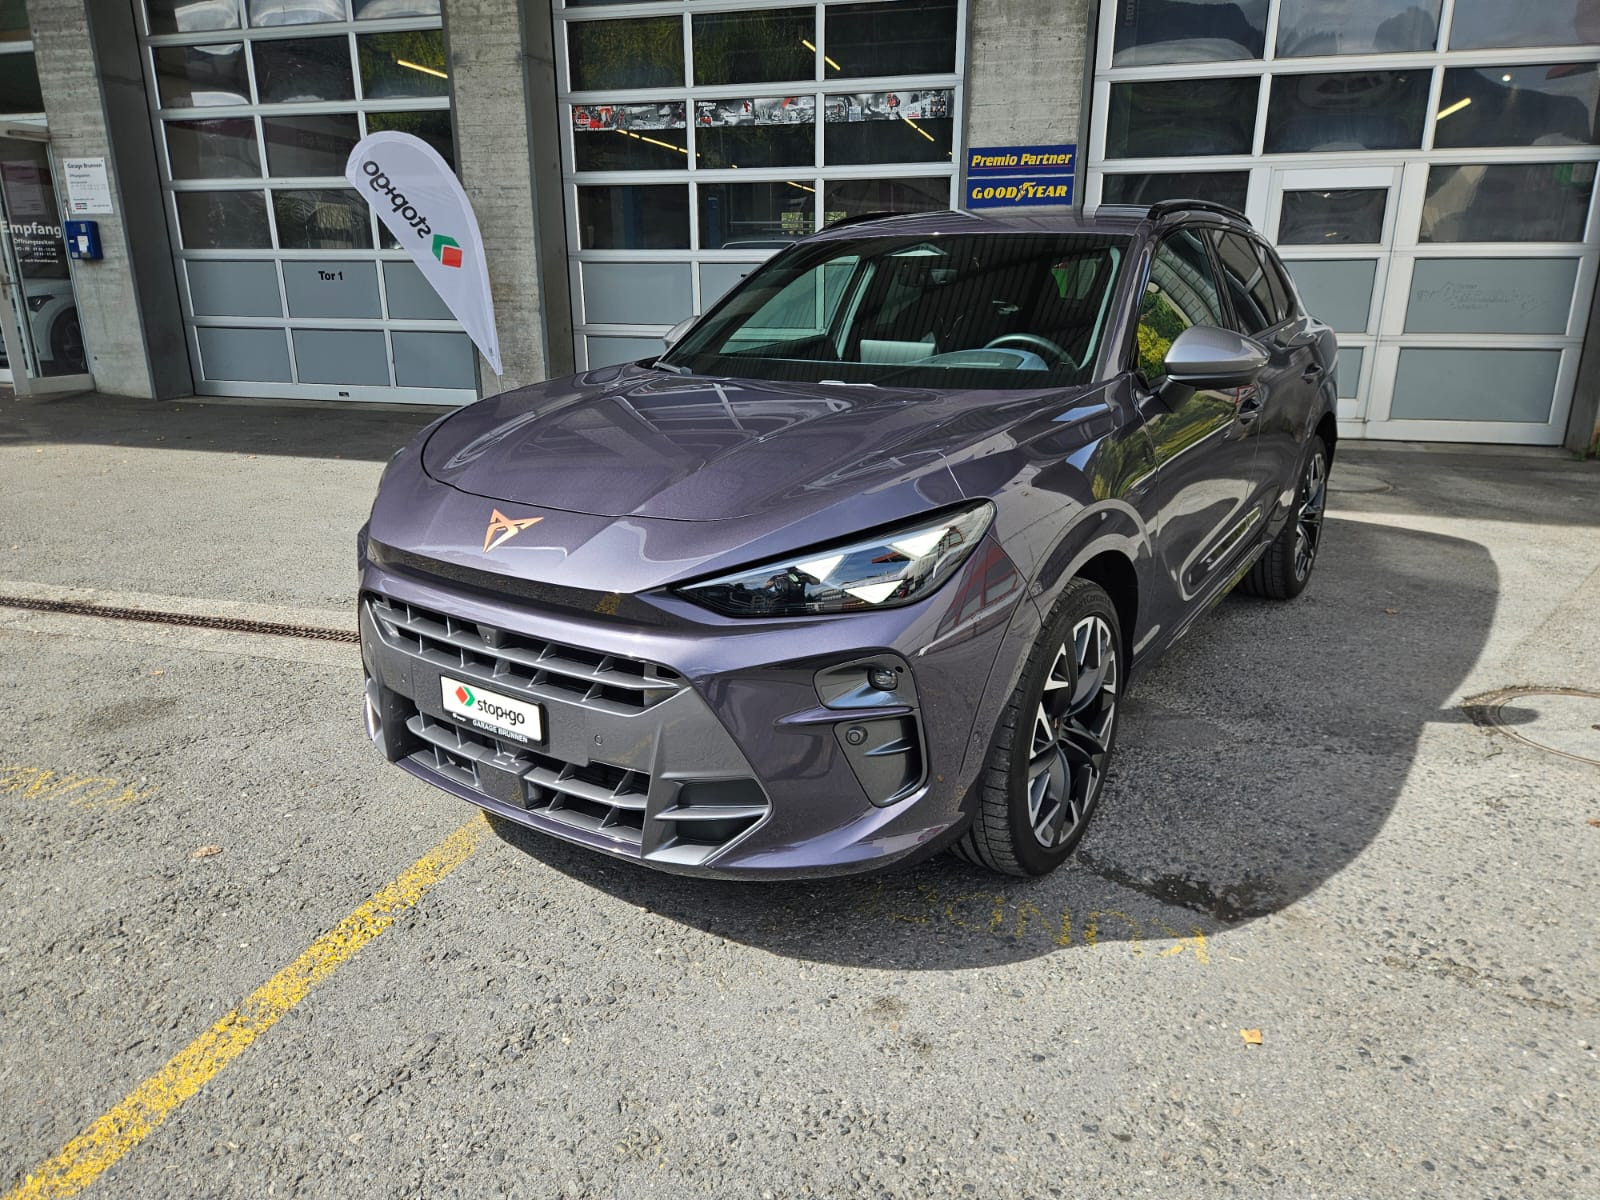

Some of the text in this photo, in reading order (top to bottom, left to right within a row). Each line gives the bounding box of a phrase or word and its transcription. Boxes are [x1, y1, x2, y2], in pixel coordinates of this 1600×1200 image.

[971, 153, 1073, 167] Premio Partner
[1, 220, 62, 239] Empfang
[317, 270, 344, 281] Tor 1
[477, 699, 525, 725] stop+go
[472, 719, 528, 744] GARAGE BRUNNEN
